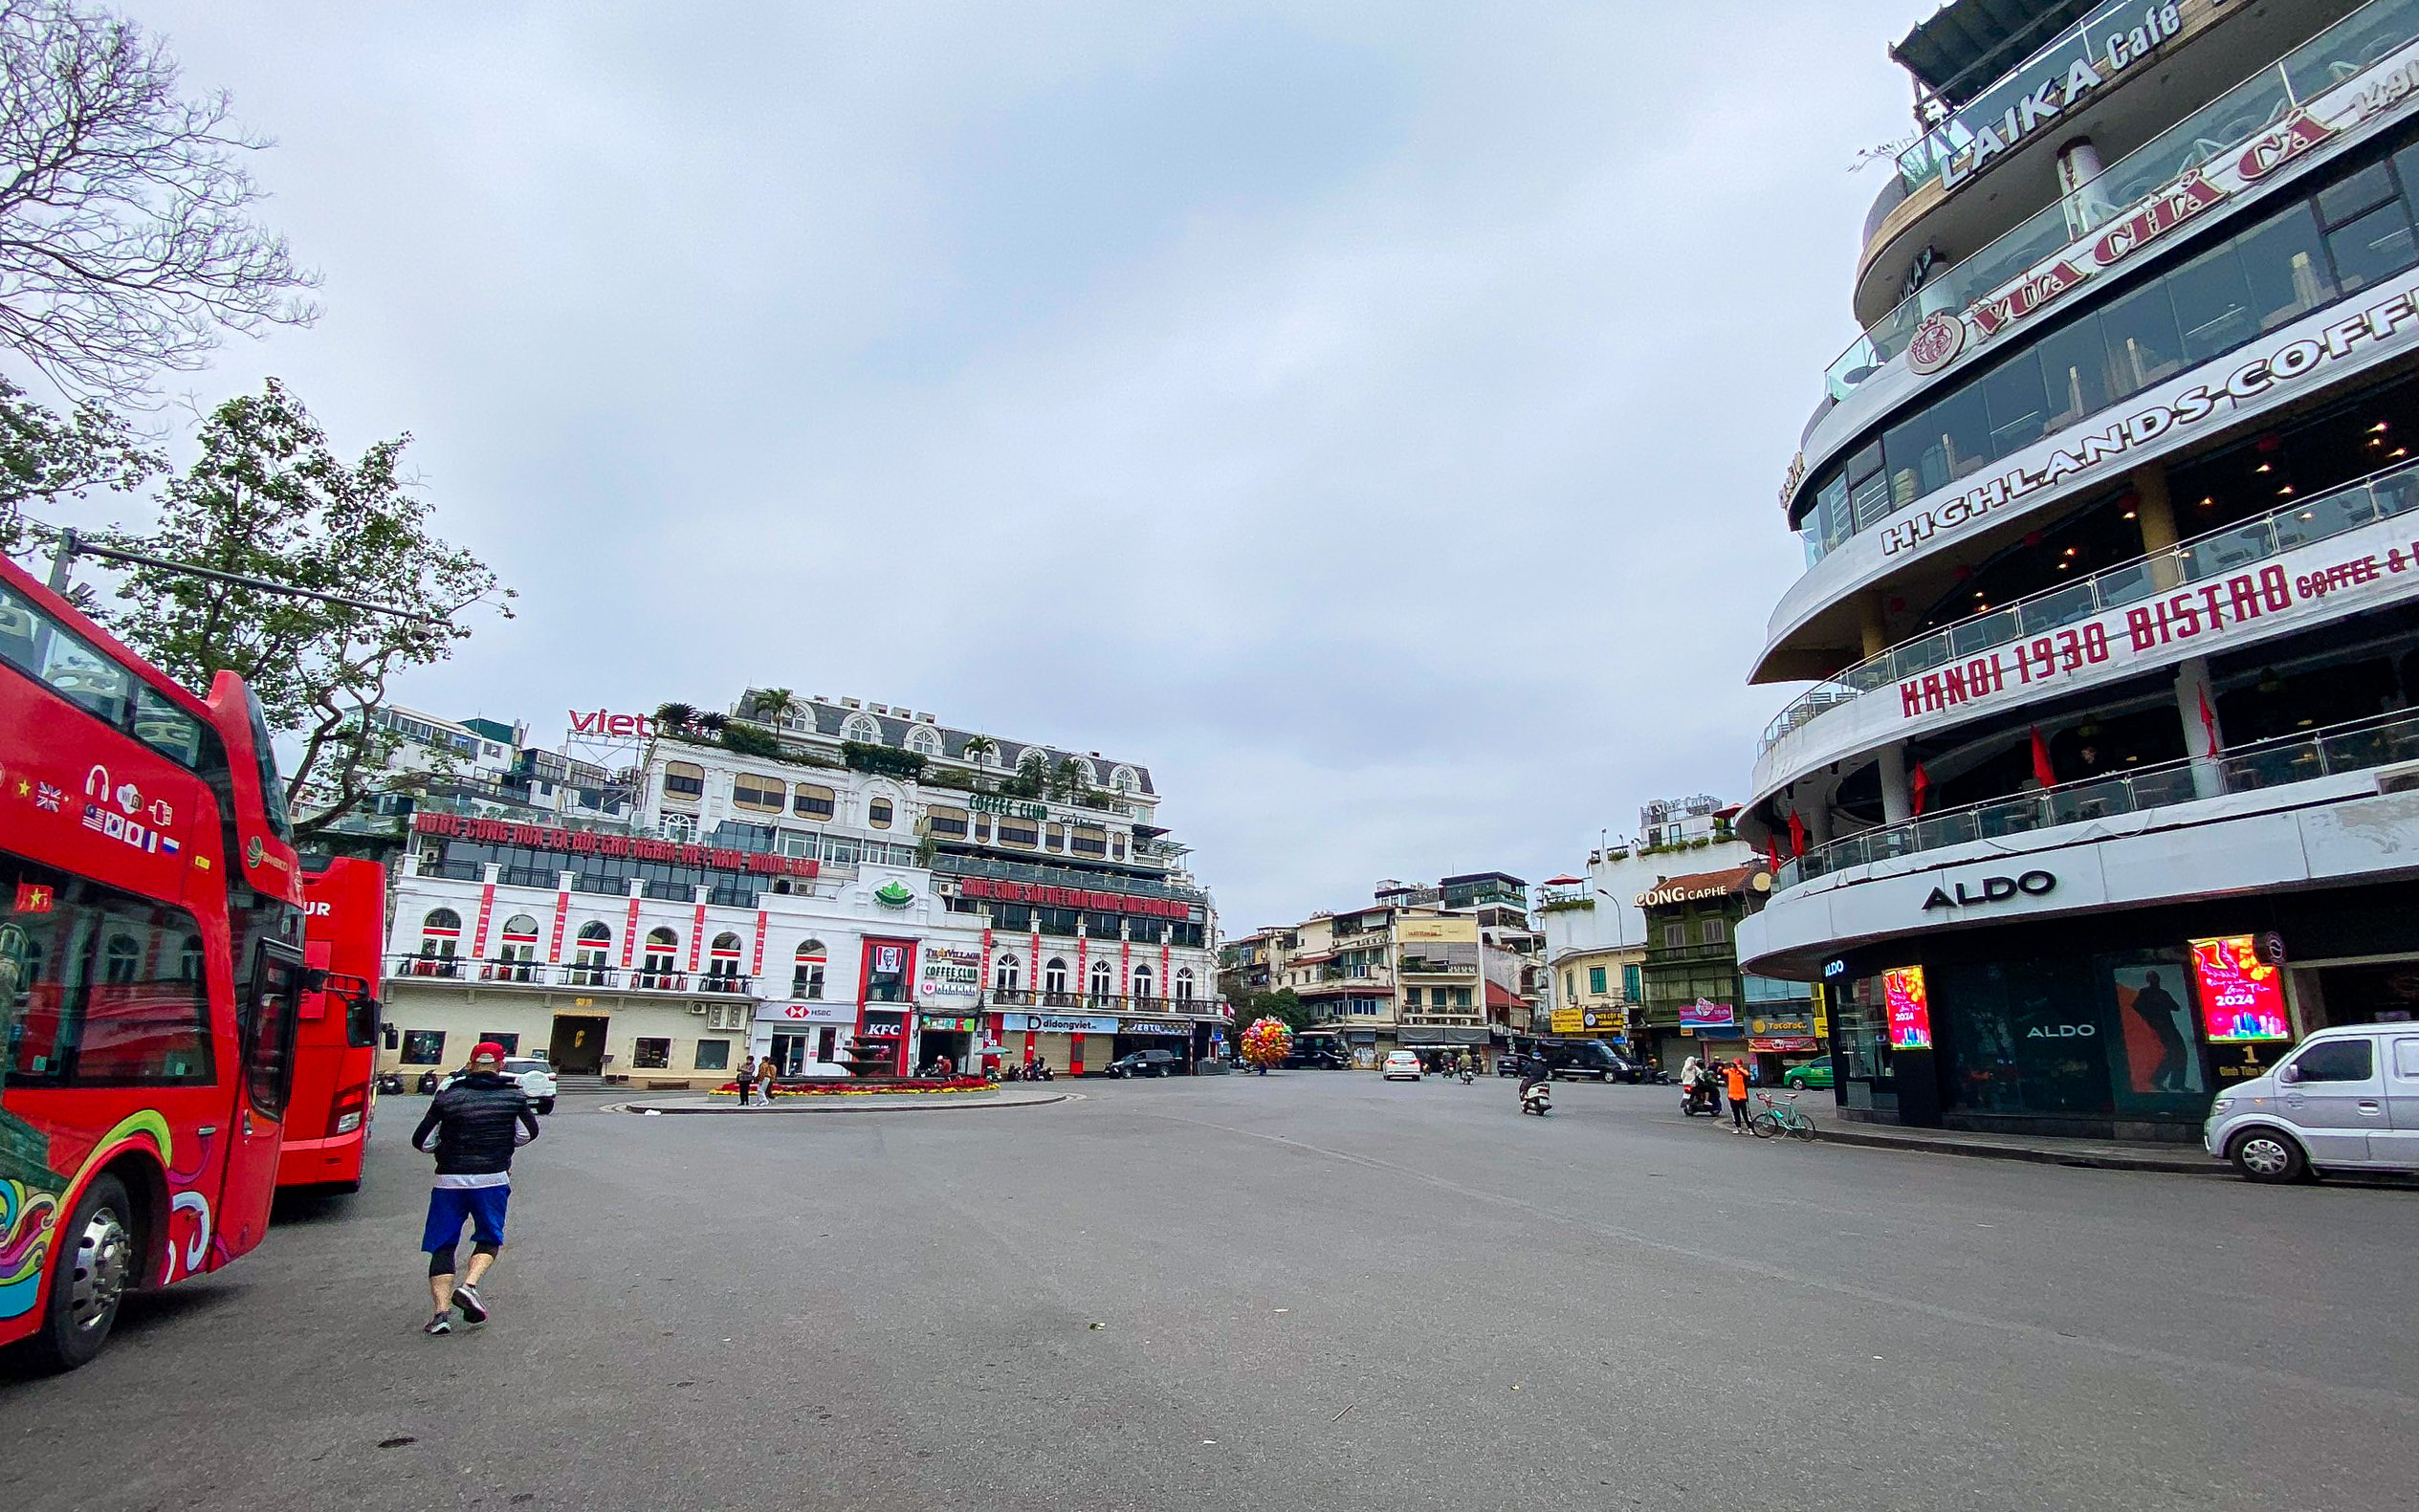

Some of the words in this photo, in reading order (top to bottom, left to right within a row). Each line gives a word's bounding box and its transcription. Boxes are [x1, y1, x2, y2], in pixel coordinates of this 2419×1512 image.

[1940, 58, 2103, 190] LAIKA
[2105, 1, 2181, 71] Café
[1970, 260, 2091, 340] VUA
[1880, 384, 2216, 556] HIGHLANDS
[1900, 654, 2004, 718] HANOI
[2014, 622, 2110, 685] 1930
[2128, 562, 2292, 651] BISTRO
[2296, 555, 2381, 599] COFFEE
[2388, 548, 2407, 573] &
[568, 708, 653, 738] viet
[969, 795, 1013, 815] COFFEE
[1020, 801, 1048, 821] CLUB
[1922, 868, 2057, 910] ALDO
[304, 901, 331, 917] UR
[925, 965, 957, 977] COFFEE
[957, 967, 979, 980] CLUB
[2214, 994, 2255, 1006] 2024
[867, 1023, 901, 1036] KFC
[2027, 1023, 2096, 1038] ALDO
[2243, 1045, 2259, 1063] 1
